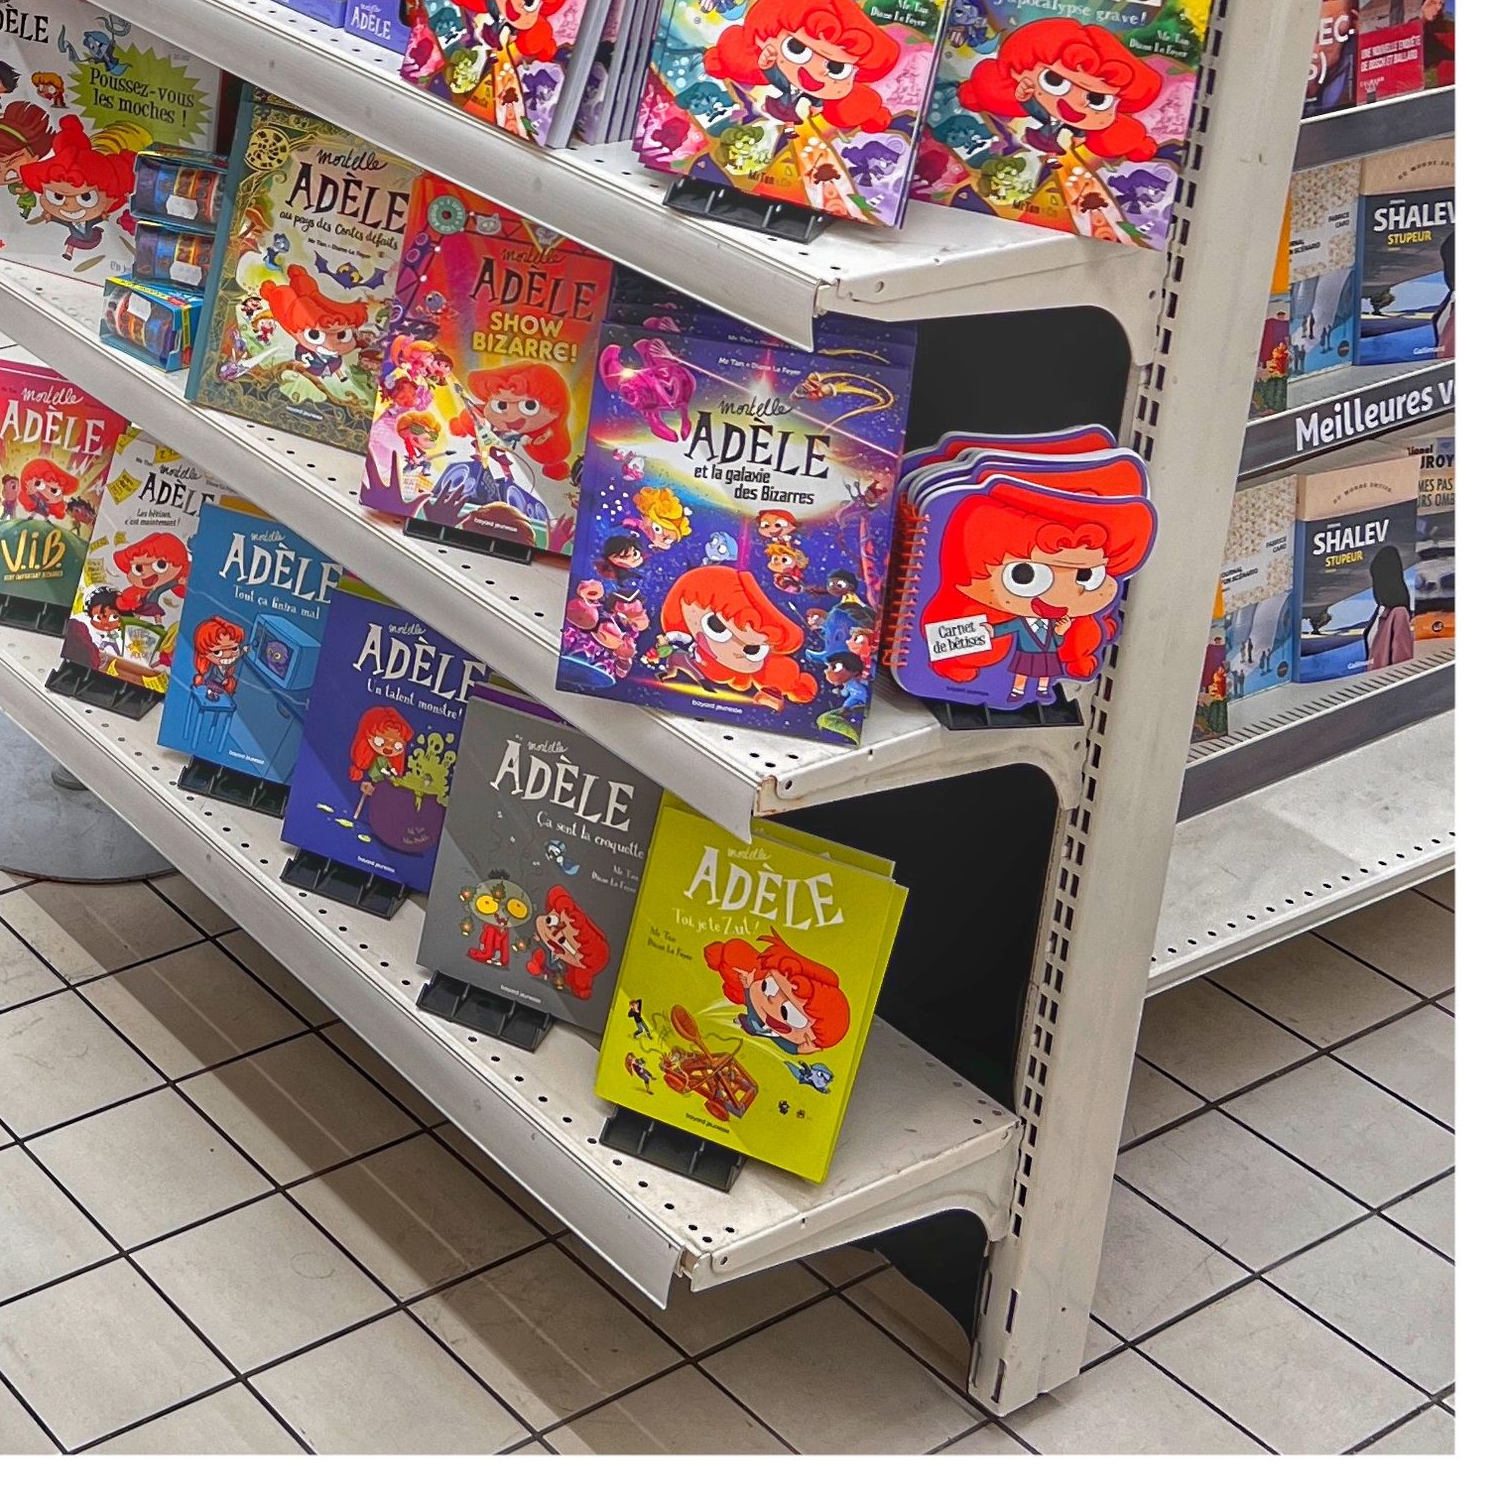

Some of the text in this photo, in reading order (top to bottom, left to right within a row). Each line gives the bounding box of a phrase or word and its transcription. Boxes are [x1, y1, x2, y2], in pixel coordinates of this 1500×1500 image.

[350, 7, 392, 40] ADÈLE
[89, 66, 196, 109] Poussez-vous
[92, 89, 188, 127] les moches !
[315, 147, 388, 171] mortelle
[284, 170, 411, 235] ADÈLE
[279, 210, 400, 252] au pays des Contes défaits
[1387, 230, 1433, 245] STUPEUR
[468, 255, 598, 324] ADÈLE
[489, 310, 565, 338] SHOW
[472, 329, 579, 363] BIZARRE!
[718, 399, 797, 418] mortelle
[1295, 381, 1435, 451] Meilleures
[684, 415, 833, 480] ADÈLE
[694, 464, 771, 487] et la galaxie
[734, 484, 815, 506] des Bizarres
[1313, 518, 1391, 557] SHALEV
[217, 532, 344, 606] ADÈLE
[1324, 551, 1363, 567] STUPEUR
[232, 585, 321, 621] Tout ça finira mal
[933, 635, 986, 654] de bêtises
[938, 621, 976, 638] Carnet
[351, 622, 489, 704] ADÈLE
[366, 678, 381, 694] Un
[382, 684, 415, 707] talent
[490, 735, 636, 833] ADÈLE
[536, 810, 645, 860] Ça sent la croquette
[683, 845, 845, 931] ADÈLE
